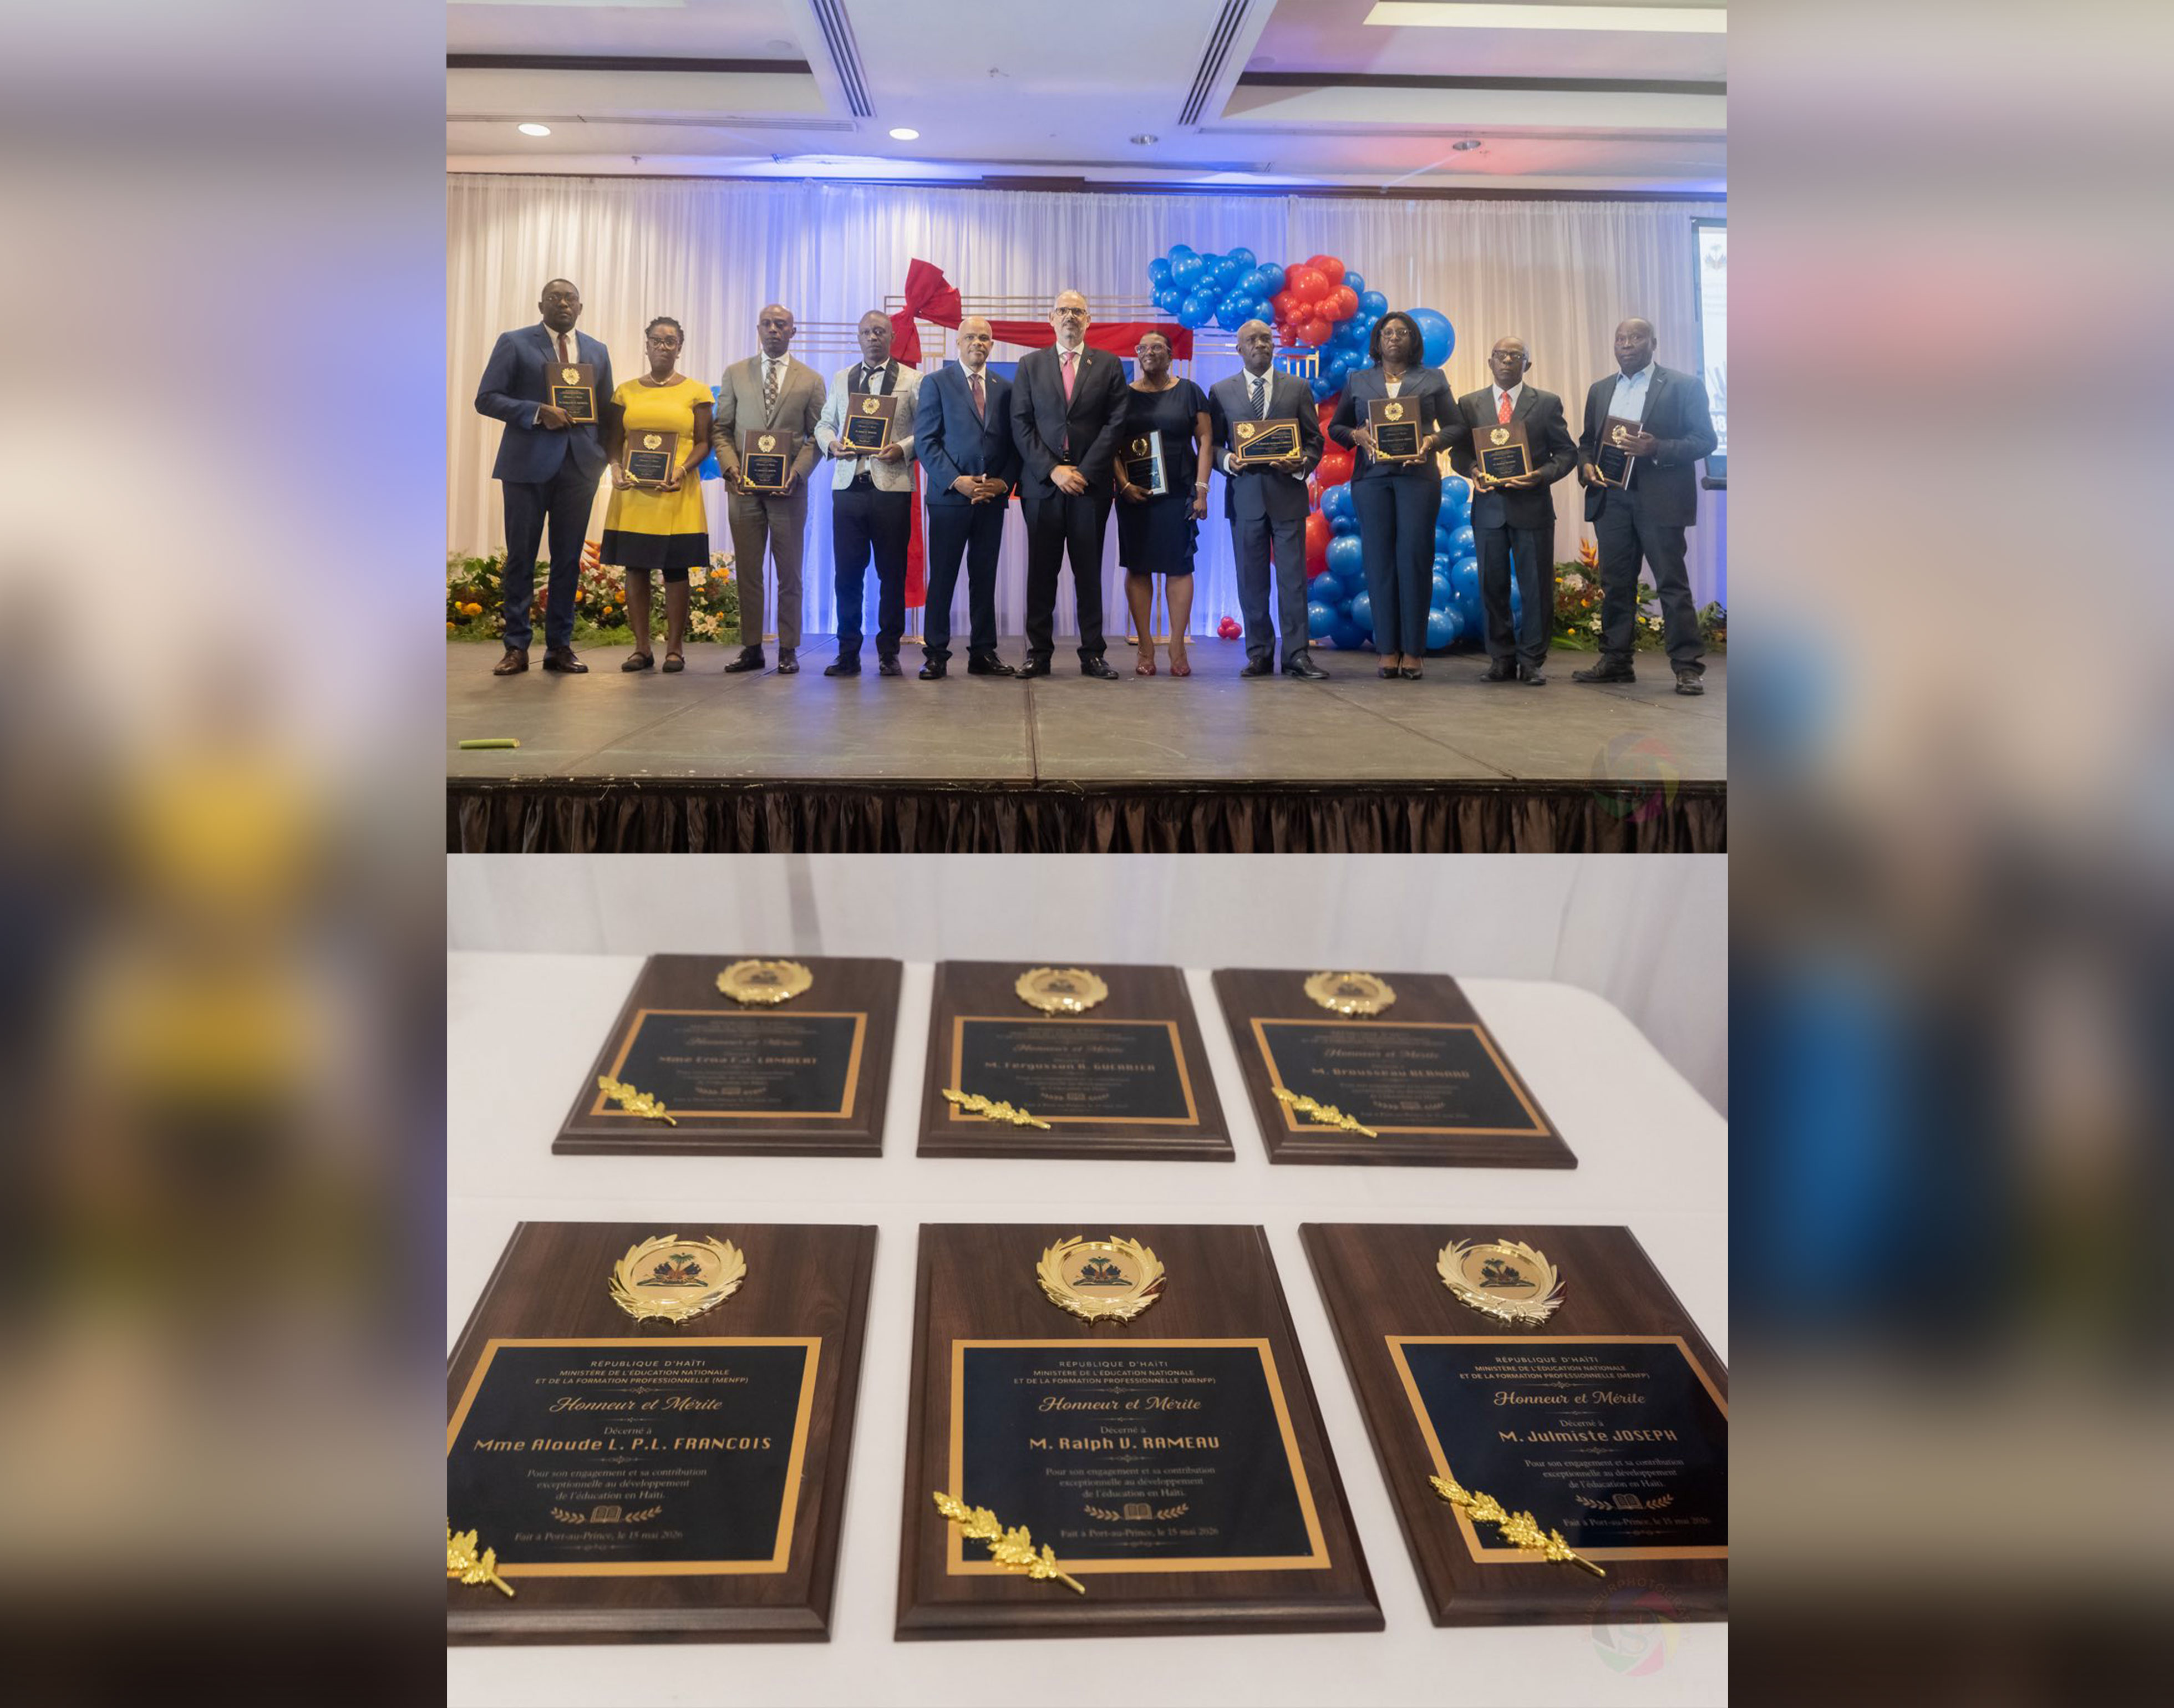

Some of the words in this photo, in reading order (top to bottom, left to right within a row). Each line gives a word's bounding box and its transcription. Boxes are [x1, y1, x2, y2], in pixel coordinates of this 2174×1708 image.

[1494, 1391, 1569, 1406] Honneur
[1574, 1393, 1587, 1404] et
[1592, 1391, 1645, 1404] Mérite
[549, 1396, 636, 1412] Honneur
[641, 1397, 659, 1411] et
[662, 1396, 723, 1411] Mérite
[1038, 1396, 1120, 1412] Honneur
[1125, 1399, 1139, 1410] et
[1145, 1396, 1202, 1410] Mérite
[604, 1426, 644, 1435] Décerné
[1100, 1426, 1138, 1434] Décerné
[1499, 1431, 1524, 1442] M.
[1528, 1430, 1609, 1442] Julmiste
[1612, 1429, 1678, 1441] JOSEPH
[474, 1439, 525, 1451] Mme
[531, 1438, 603, 1451] Aloude
[608, 1438, 624, 1451] L.
[632, 1437, 667, 1451] P.L.
[674, 1437, 771, 1450] FRANCOIS
[1030, 1437, 1053, 1450] M.
[1059, 1437, 1113, 1452] Ralph
[1142, 1436, 1220, 1449] RAMEAU
[1565, 1460, 1613, 1468] engagement
[570, 1470, 626, 1478] engagement
[1086, 1468, 1139, 1477] engagement
[1542, 1470, 1601, 1480] exceptionnelle
[536, 1480, 603, 1490] exceptionnelle
[1059, 1478, 1121, 1488] exceptionnelle
[1568, 1481, 1578, 1489] de
[555, 1492, 567, 1500] de
[1081, 1490, 1093, 1498] de
